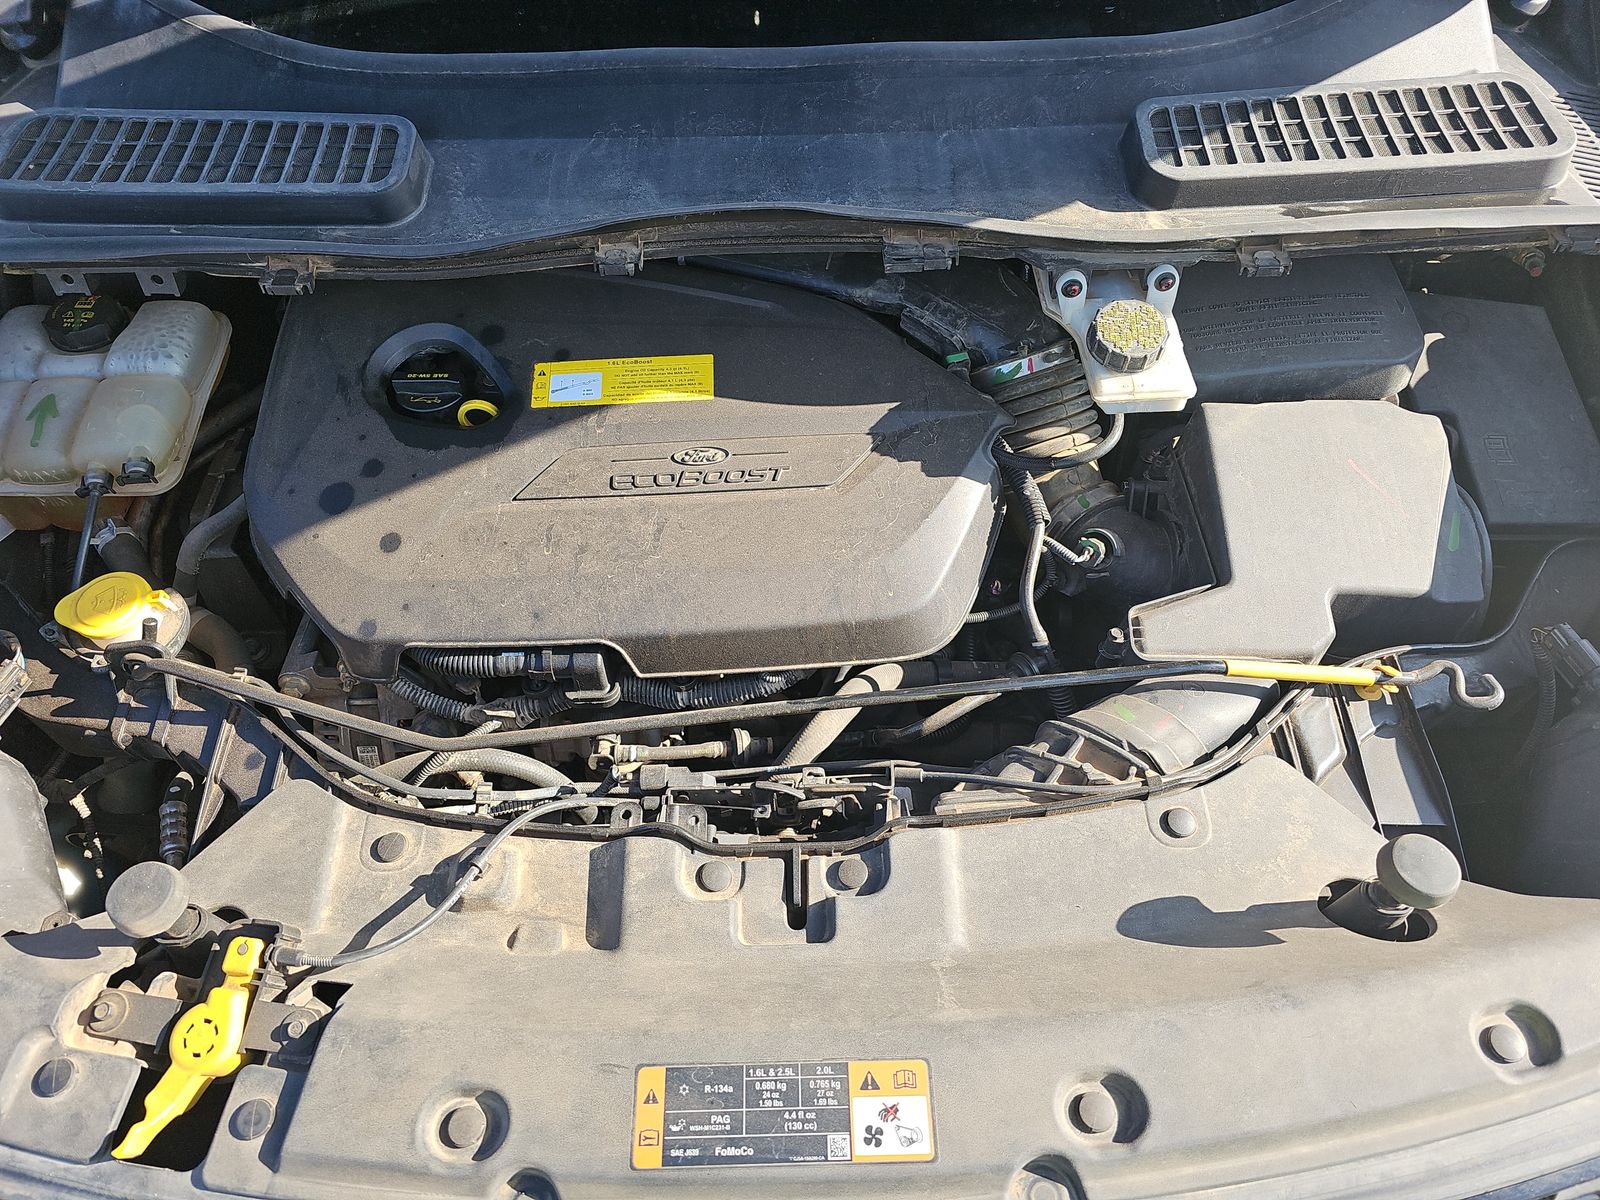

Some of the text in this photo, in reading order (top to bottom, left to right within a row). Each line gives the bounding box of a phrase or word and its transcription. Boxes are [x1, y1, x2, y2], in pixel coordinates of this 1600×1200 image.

[676, 448, 723, 464] Ford
[749, 1069, 767, 1077] 1.6L
[777, 1068, 796, 1076] 2.5L
[816, 1066, 835, 1075] 2.0L
[704, 1084, 734, 1094] R-134a
[755, 1080, 787, 1092] 0.680 kg
[809, 1079, 841, 1091] 0.765 kg
[762, 1091, 771, 1099] 24
[773, 1099, 784, 1107] lbs
[813, 1098, 839, 1106] 1.69 lbs
[710, 1115, 731, 1124] PAG
[784, 1111, 797, 1120] 4.4
[798, 1111, 805, 1119] fl
[784, 1120, 818, 1132] (130 cc)
[670, 1149, 684, 1157] SAE
[714, 1146, 755, 1157] FoMoCo
